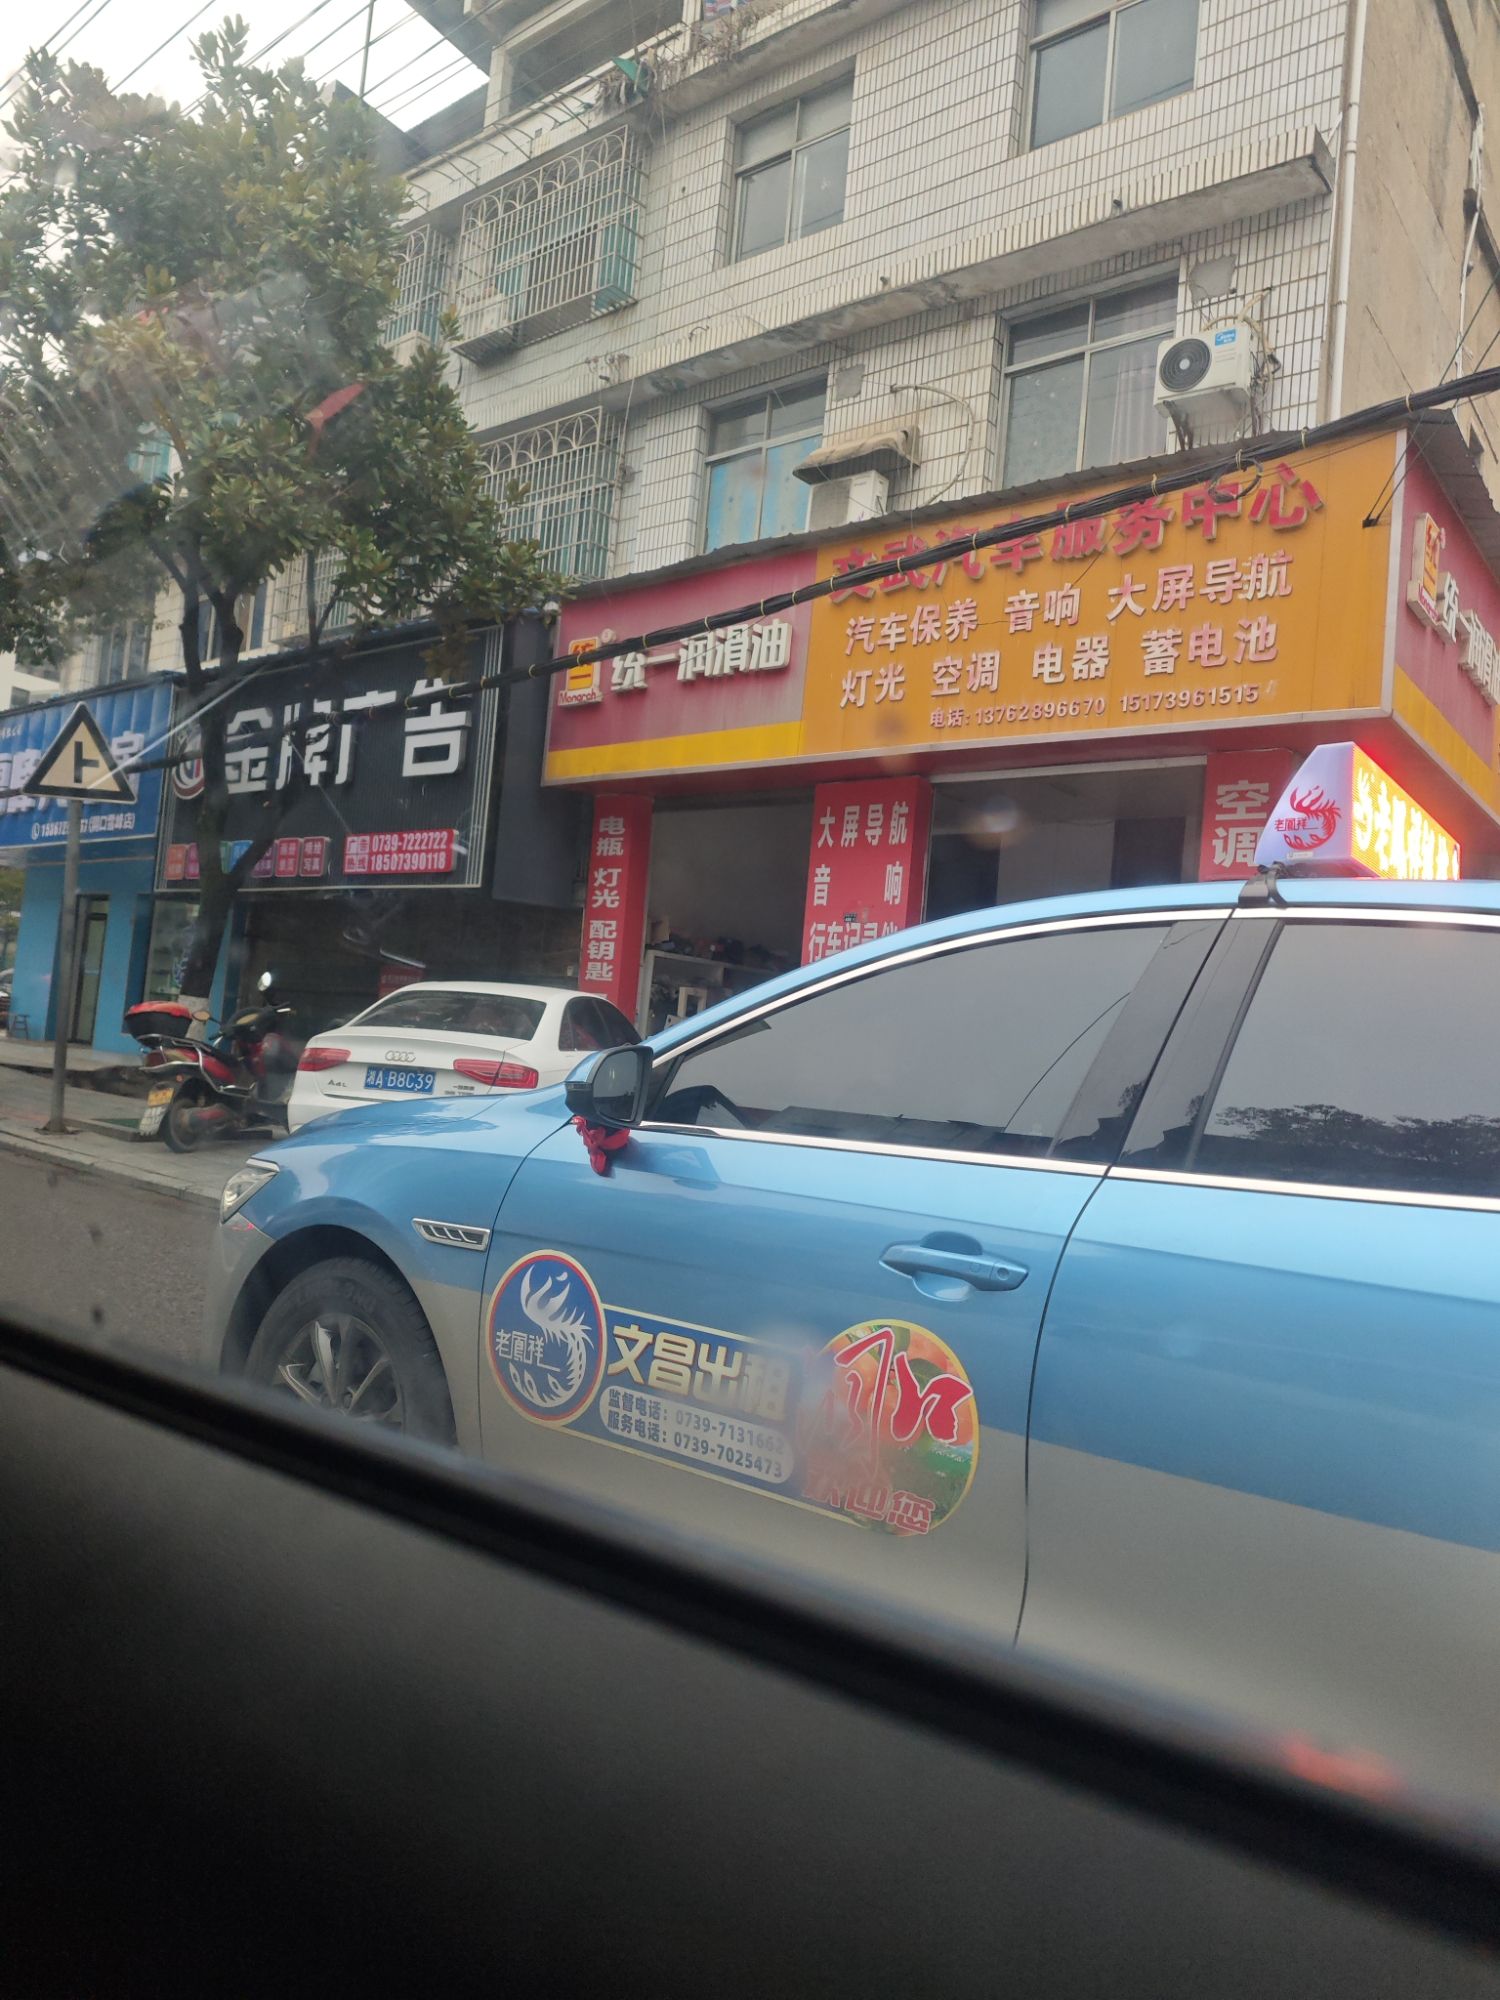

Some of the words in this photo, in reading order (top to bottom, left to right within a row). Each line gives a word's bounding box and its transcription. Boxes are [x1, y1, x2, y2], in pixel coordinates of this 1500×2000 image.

[845, 598, 978, 655] 汽车保养
[1004, 583, 1081, 633] 音响
[1107, 549, 1294, 621] 大屏导航
[610, 618, 793, 692] 统一润滑油
[840, 662, 905, 708] 灯光
[930, 649, 1000, 697] 空调
[1032, 636, 1110, 685] 电器
[1141, 616, 1279, 678] 蓄电池
[1120, 684, 1258, 713] 15173961515
[224, 677, 472, 796] 金牌广告
[370, 831, 447, 852] 0739-7222722
[596, 815, 625, 857] 电瓶
[817, 800, 909, 848] 大屏导航
[1212, 779, 1270, 869] 空调
[369, 852, 446, 871] 18507390118
[592, 867, 622, 908] 灯光
[585, 919, 617, 982] 配钥匙
[607, 1324, 790, 1422] 文昌出租
